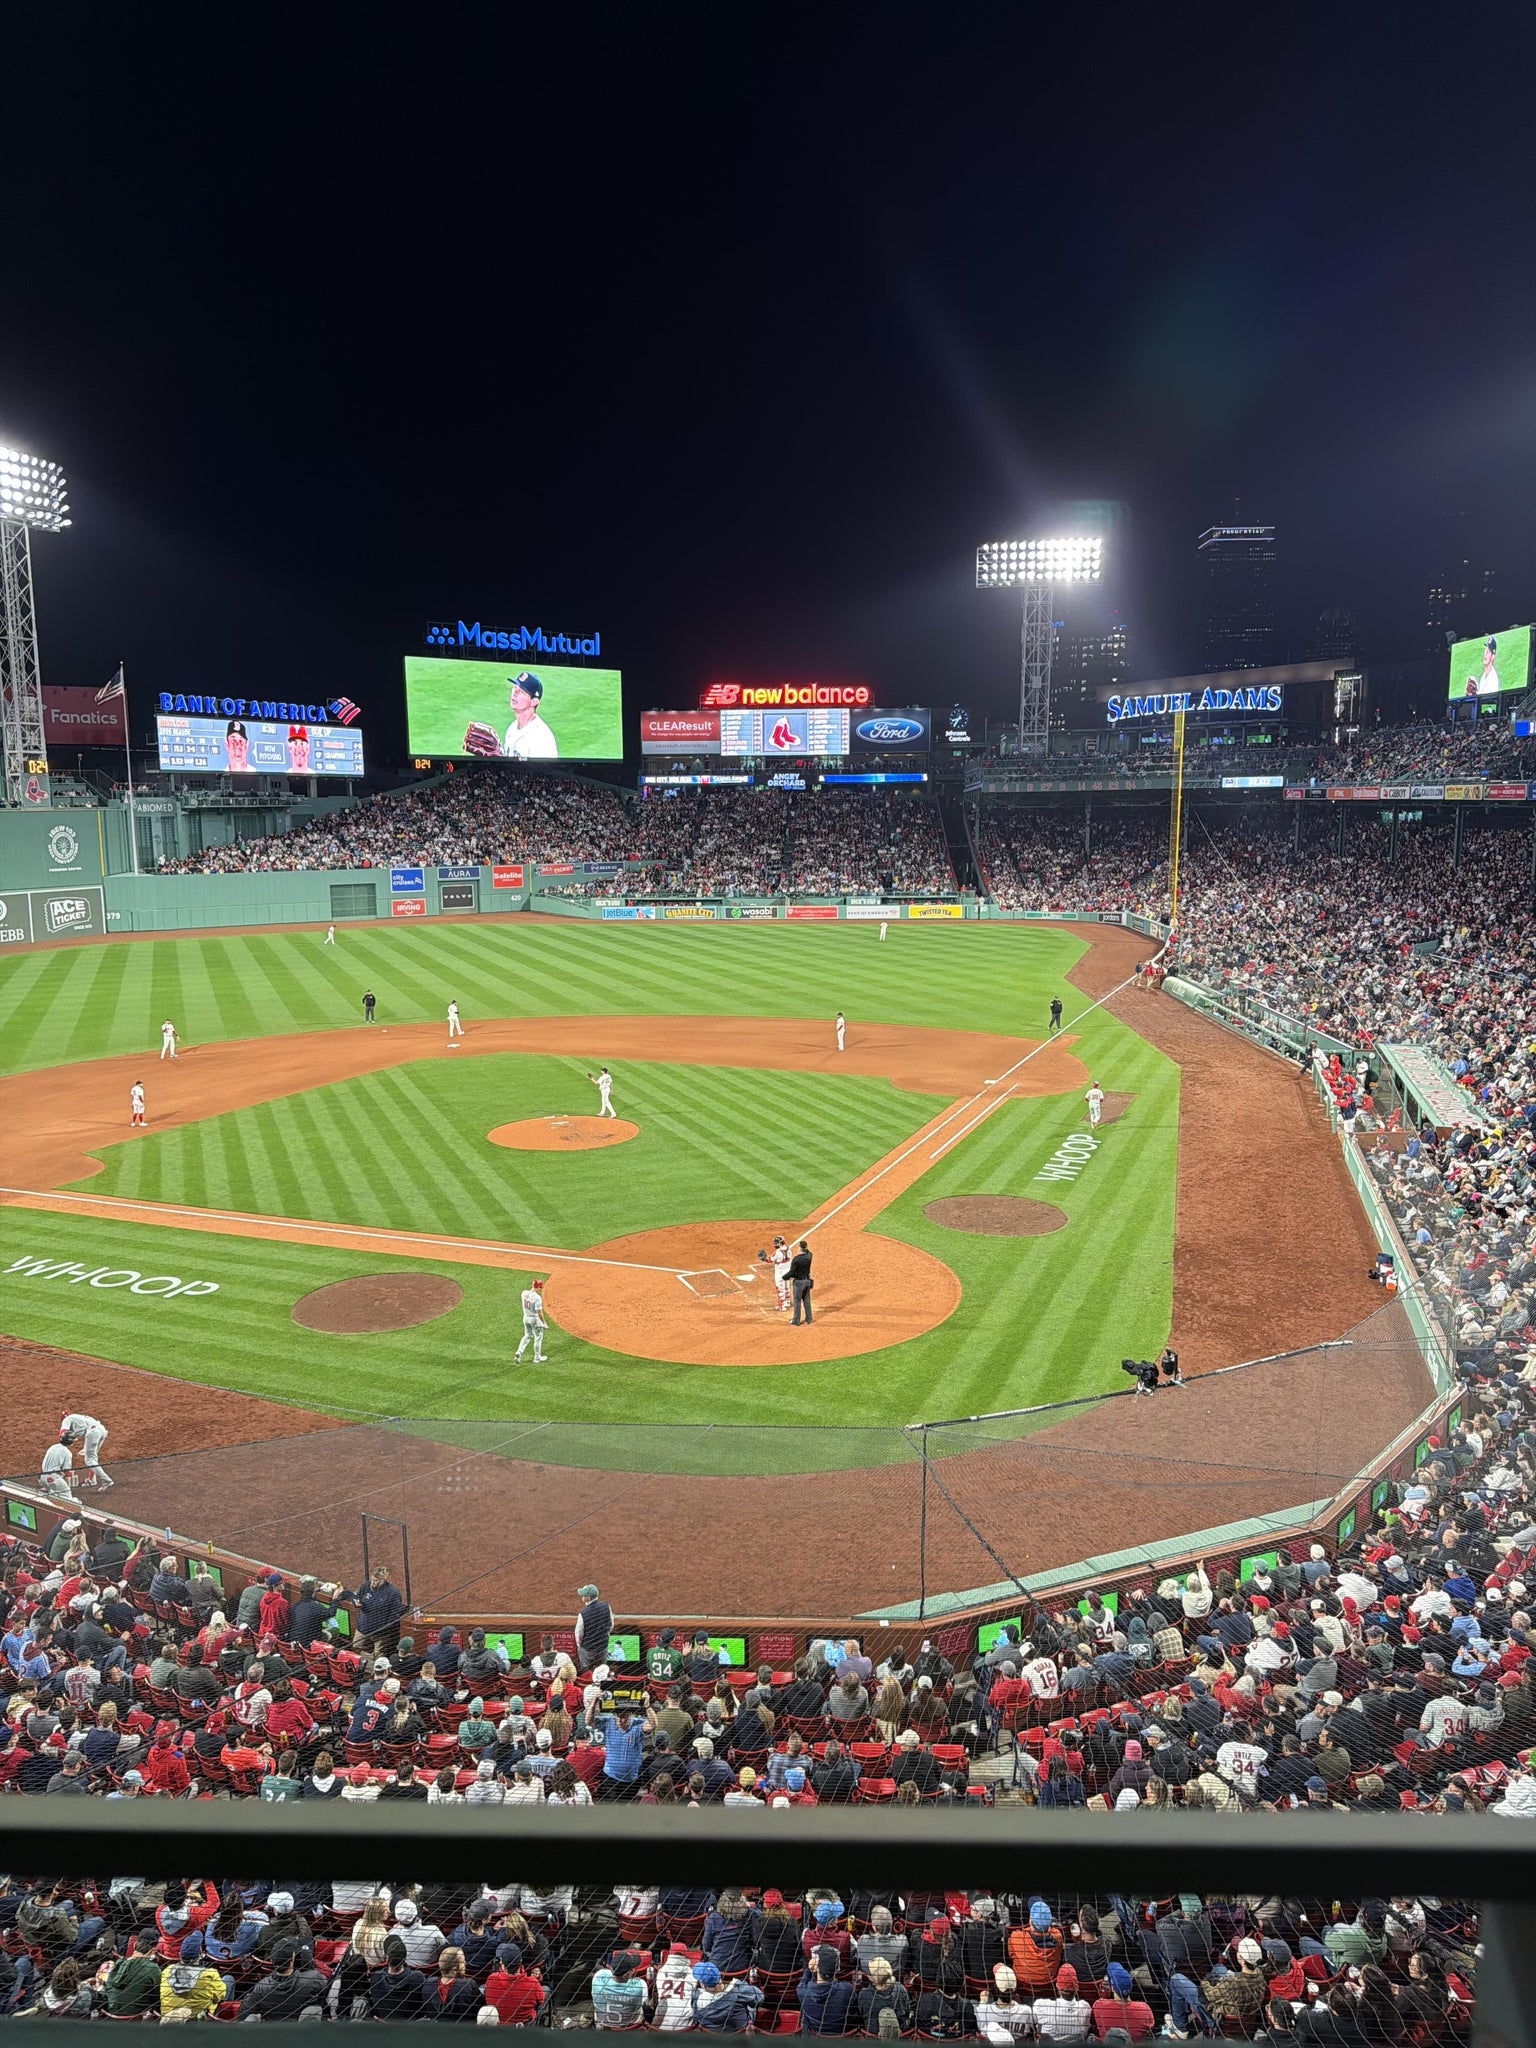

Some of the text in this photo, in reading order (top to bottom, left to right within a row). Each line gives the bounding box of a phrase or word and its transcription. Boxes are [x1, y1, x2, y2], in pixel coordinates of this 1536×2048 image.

[458, 620, 600, 656] MassMutual
[742, 687, 782, 704] new
[784, 683, 868, 704] balance
[160, 692, 328, 722] BANK OF AMERICA
[1107, 686, 1282, 722] SAMUEL ADAMS
[50, 709, 118, 725] Fanatics
[649, 721, 712, 731] CLEAResult
[870, 721, 910, 740] Ford
[28, 760, 48, 774] 0:24
[415, 758, 431, 769] 0:24
[137, 803, 173, 812] ABIOMED
[48, 826, 77, 838] IBEW 103
[554, 866, 574, 874] TICKET
[54, 900, 86, 916] ACE
[106, 912, 120, 920] 379
[606, 908, 633, 918] jetBlue
[666, 908, 714, 918] GRANITE CITY
[742, 908, 772, 916] wasabi
[918, 908, 952, 917] TWISTED TEA
[55, 910, 86, 925] TICKET
[1032, 1134, 1102, 1180] WHOOP
[2, 1256, 220, 1298] WHOOP
[1096, 1622, 1114, 1638] 34
[654, 1653, 672, 1662] ORTIZ
[652, 1662, 674, 1677] 34
[1040, 1670, 1057, 1689] 16
[71, 1684, 84, 1700] 11
[362, 1710, 380, 1732] 3
[1444, 1718, 1464, 1736] 34
[1234, 1751, 1252, 1760] ORTIZ
[1232, 1759, 1254, 1776] 34
[632, 1898, 641, 1916] 7
[660, 1980, 686, 2000] 24
[605, 2002, 622, 2024] 5
